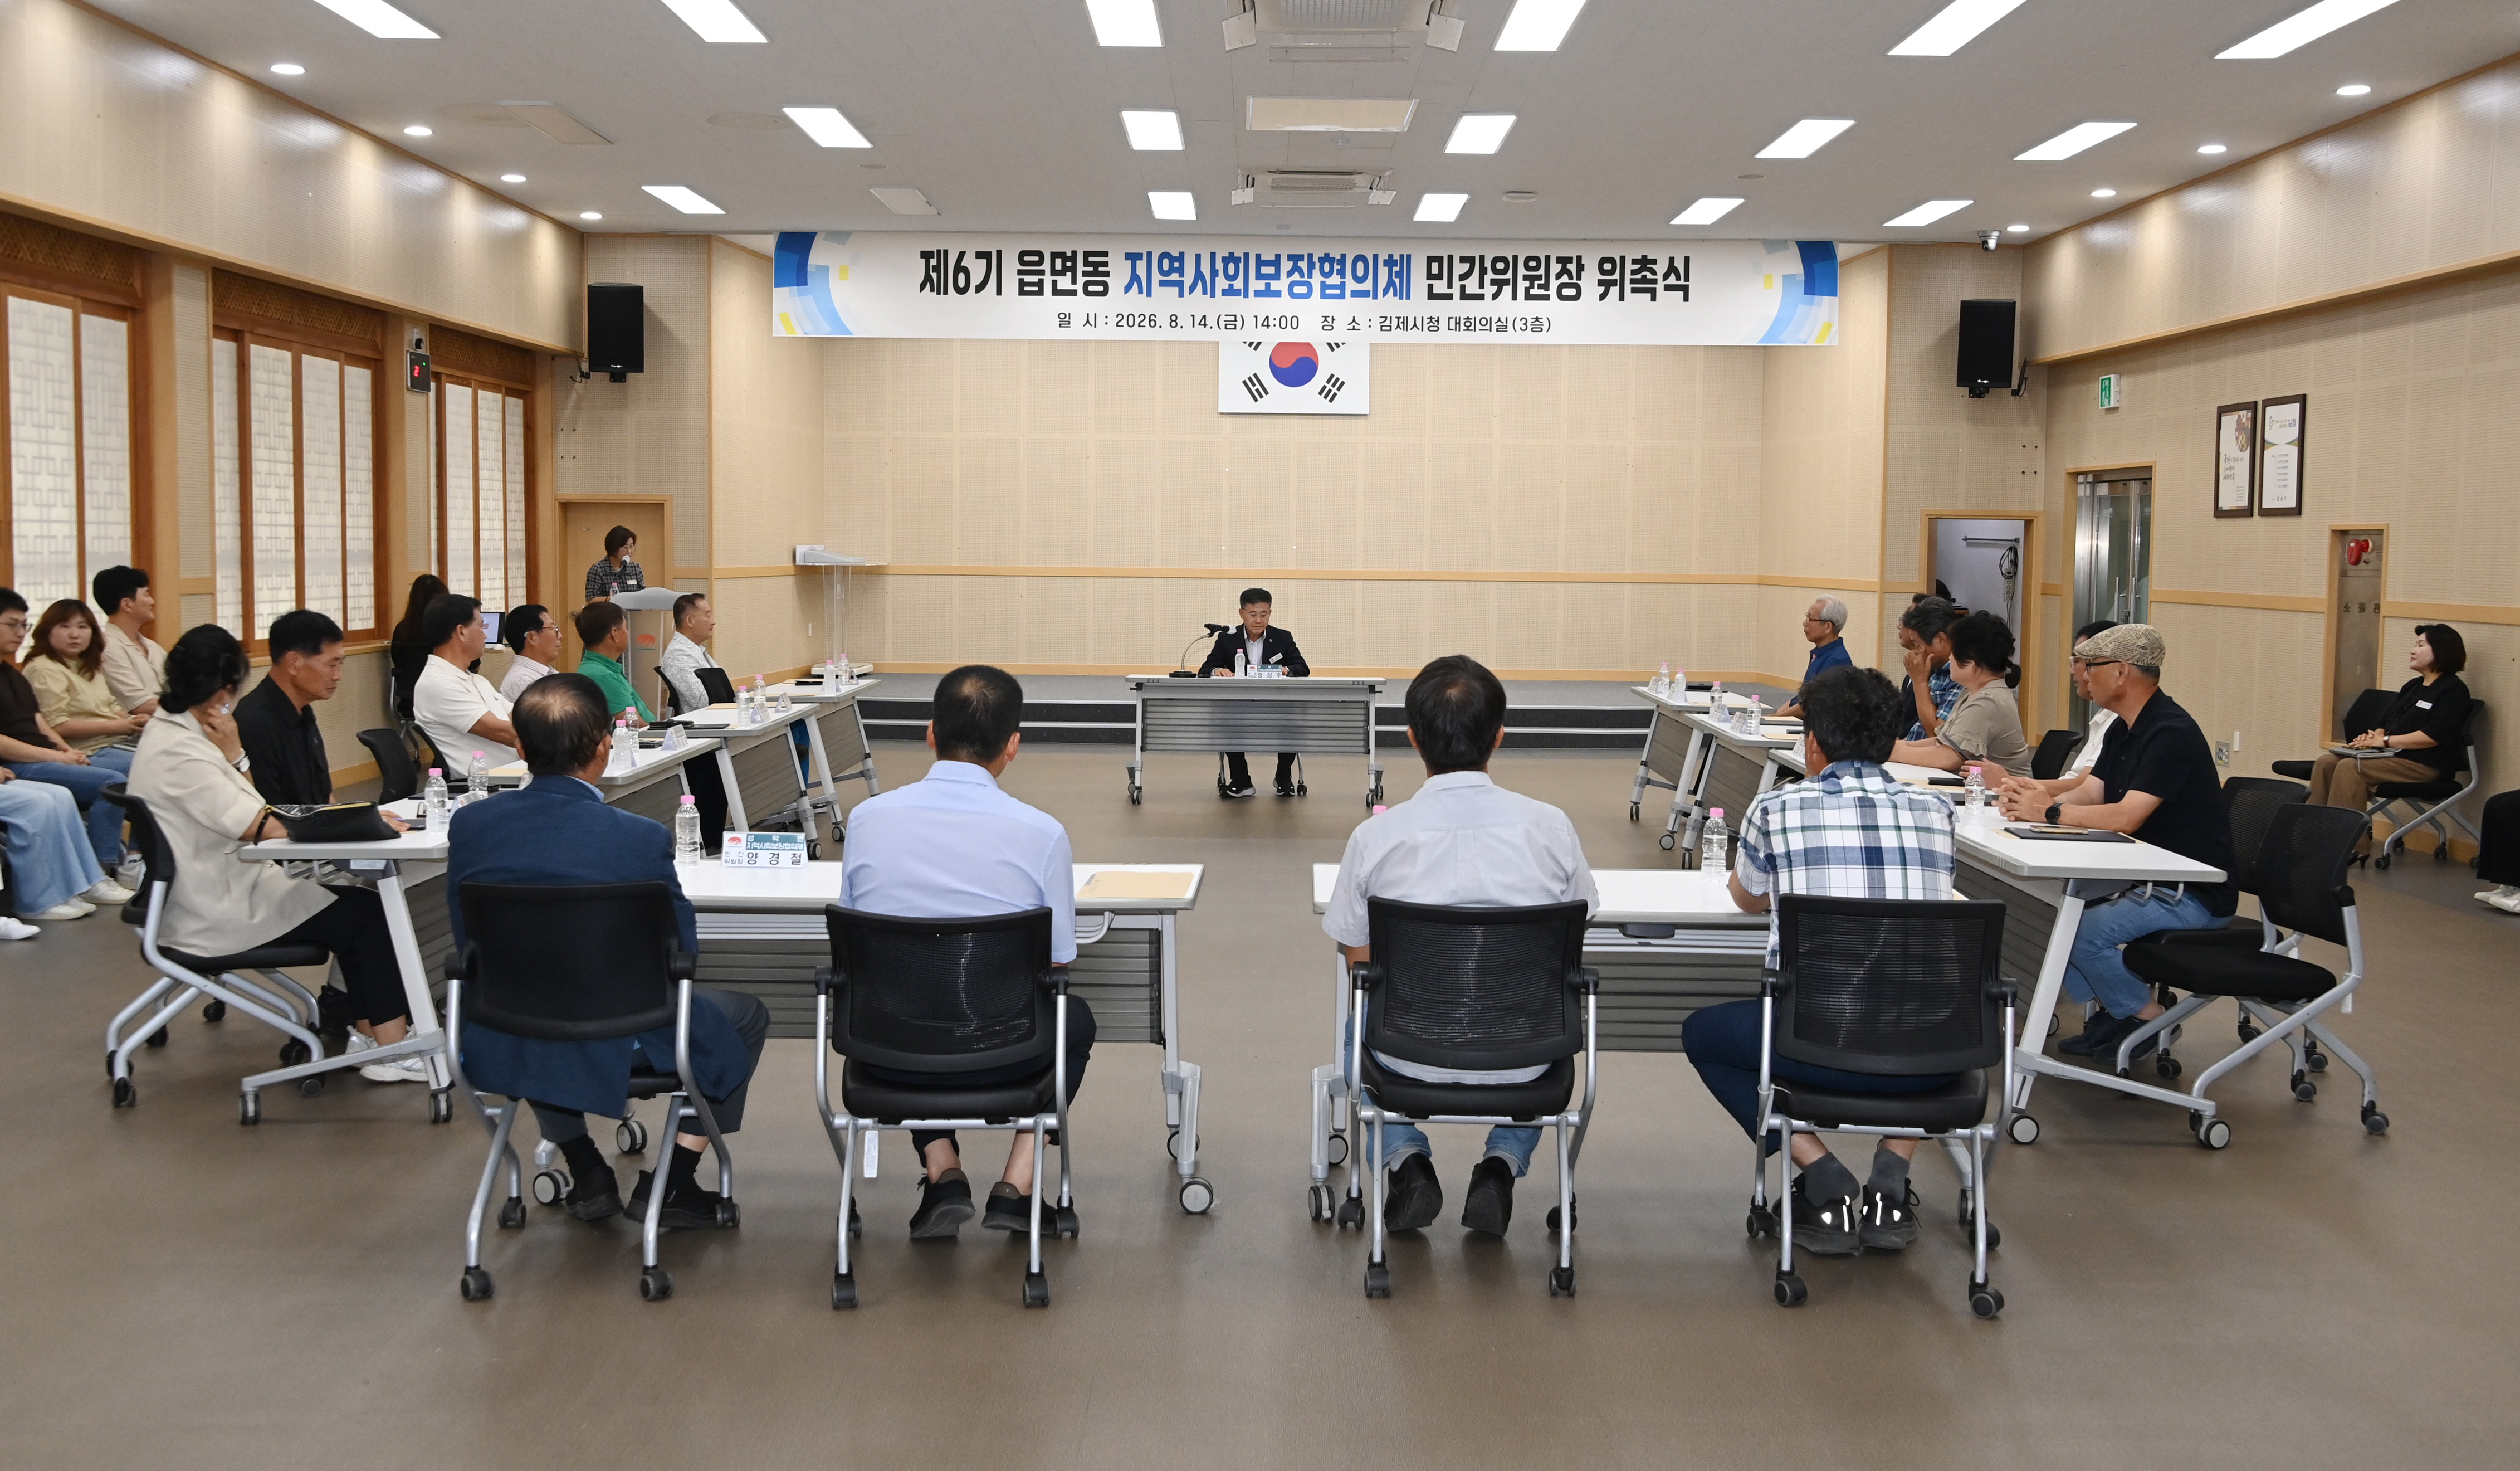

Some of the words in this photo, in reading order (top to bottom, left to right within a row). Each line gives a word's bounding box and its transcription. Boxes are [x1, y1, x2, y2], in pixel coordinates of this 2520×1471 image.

[919, 249, 1003, 296] 제6기
[1017, 250, 1110, 297] 읍면동
[1124, 251, 1412, 300] 지역사회보장협의체
[1426, 254, 1585, 301] 민간위원장
[1597, 254, 1691, 302] 위촉식
[1116, 313, 1163, 329] 2026.
[1169, 313, 1184, 329] 8.
[1190, 314, 1245, 330] 14.(금)
[1253, 315, 1299, 330] 14:00
[1379, 315, 1440, 332] 김제시청
[1447, 316, 1551, 333] 대회의실(3층)
